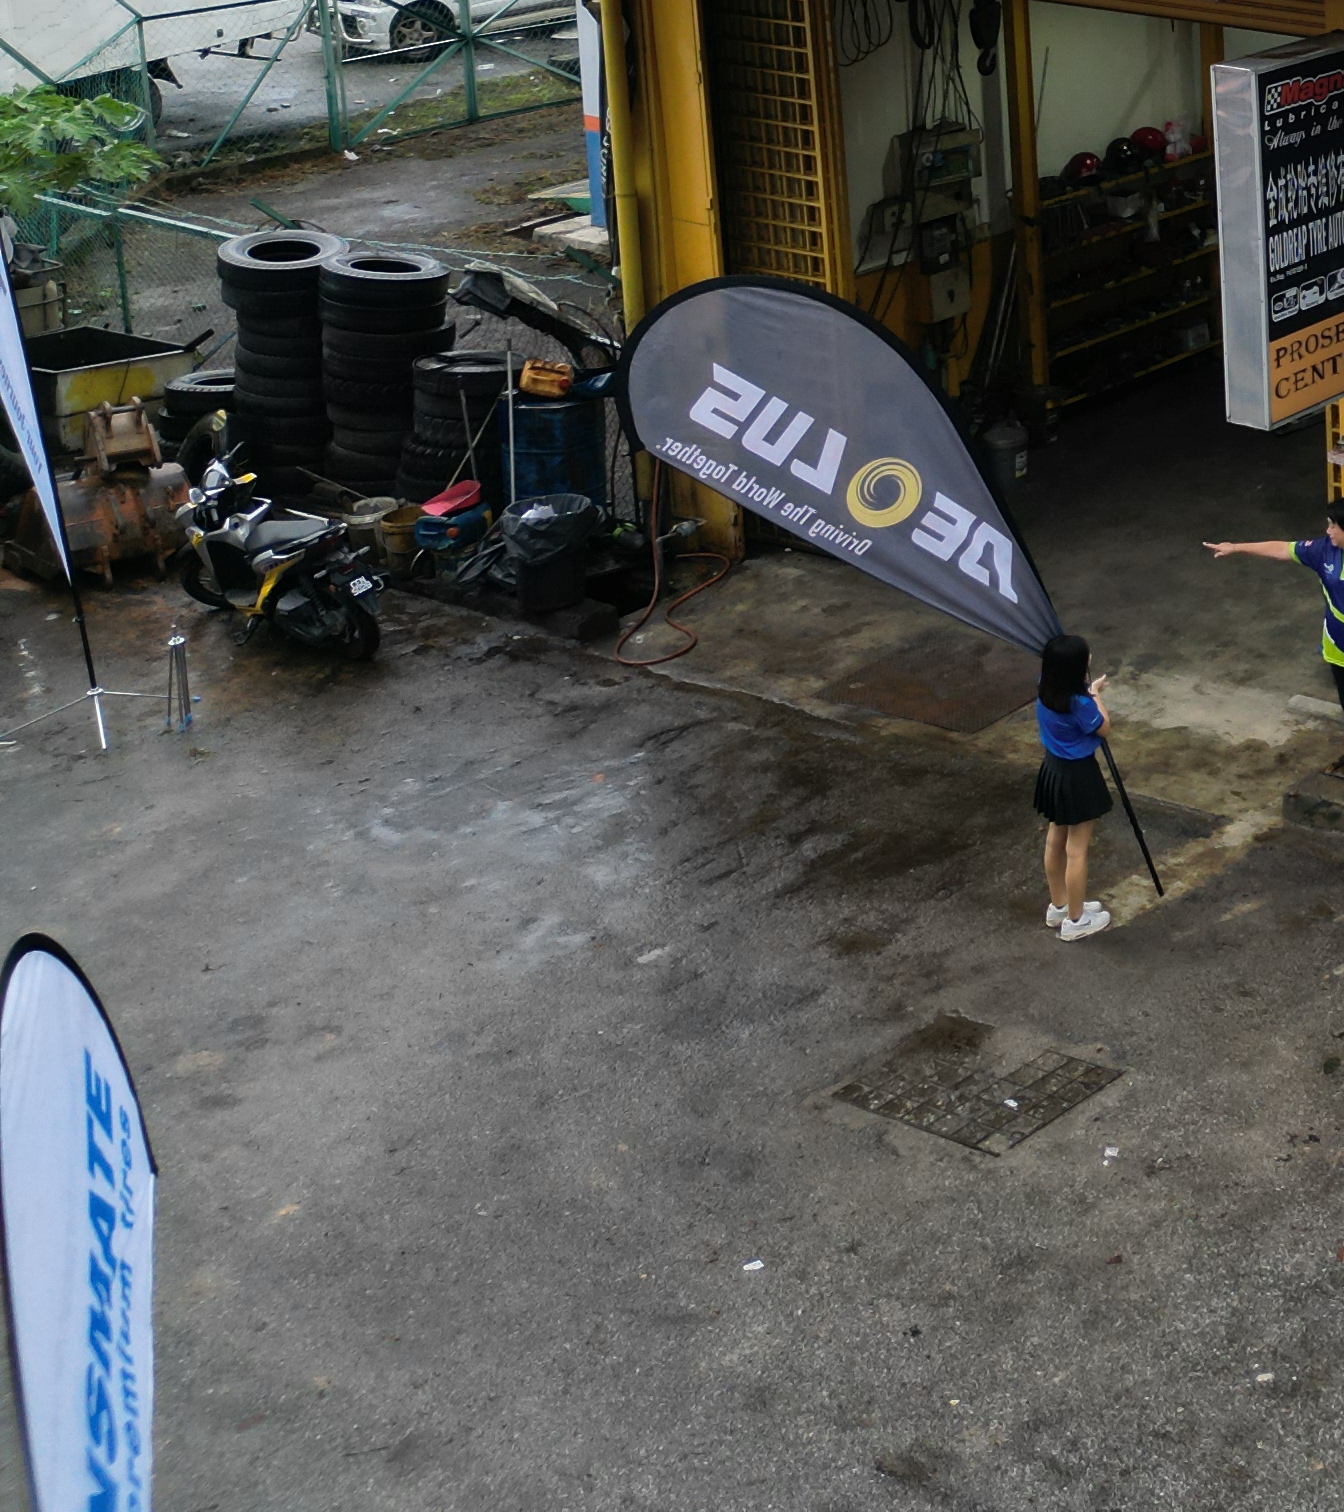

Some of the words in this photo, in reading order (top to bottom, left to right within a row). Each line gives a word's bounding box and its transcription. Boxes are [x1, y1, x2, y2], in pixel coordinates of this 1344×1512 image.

[1311, 122, 1321, 137] in
[1269, 224, 1308, 273] GOLDREAP
[1308, 217, 1327, 258] TYRE
